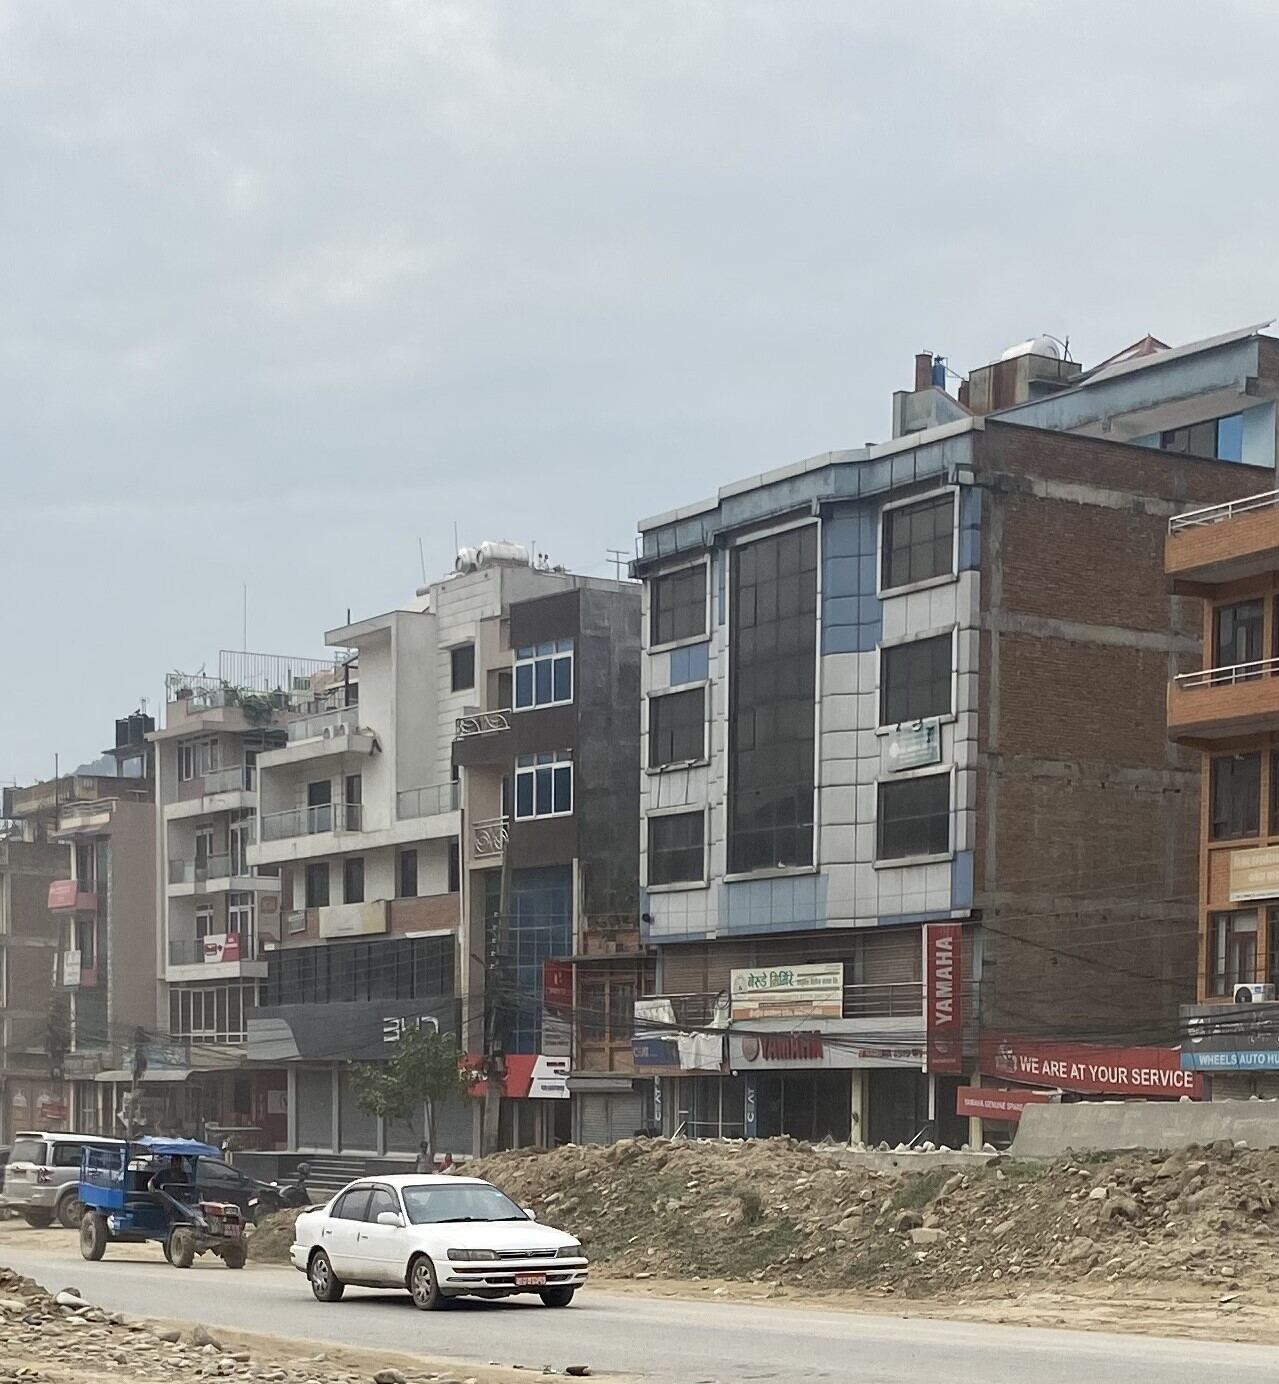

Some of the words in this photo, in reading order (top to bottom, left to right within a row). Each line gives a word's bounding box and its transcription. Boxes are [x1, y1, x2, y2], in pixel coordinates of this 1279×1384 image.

[935, 936, 953, 1025] YAMAHA
[760, 1031, 825, 1061] YAMAHA
[1199, 1053, 1237, 1066] WHEELS
[1239, 1052, 1266, 1065] AUTO
[1020, 1056, 1039, 1074] WE
[1042, 1059, 1068, 1078] ARE
[1070, 1063, 1086, 1081] AT
[1089, 1064, 1129, 1085] YOUR
[1131, 1068, 1194, 1088] SERVICE
[654, 1087, 662, 1121] CAT
[747, 1087, 755, 1122] CAT
